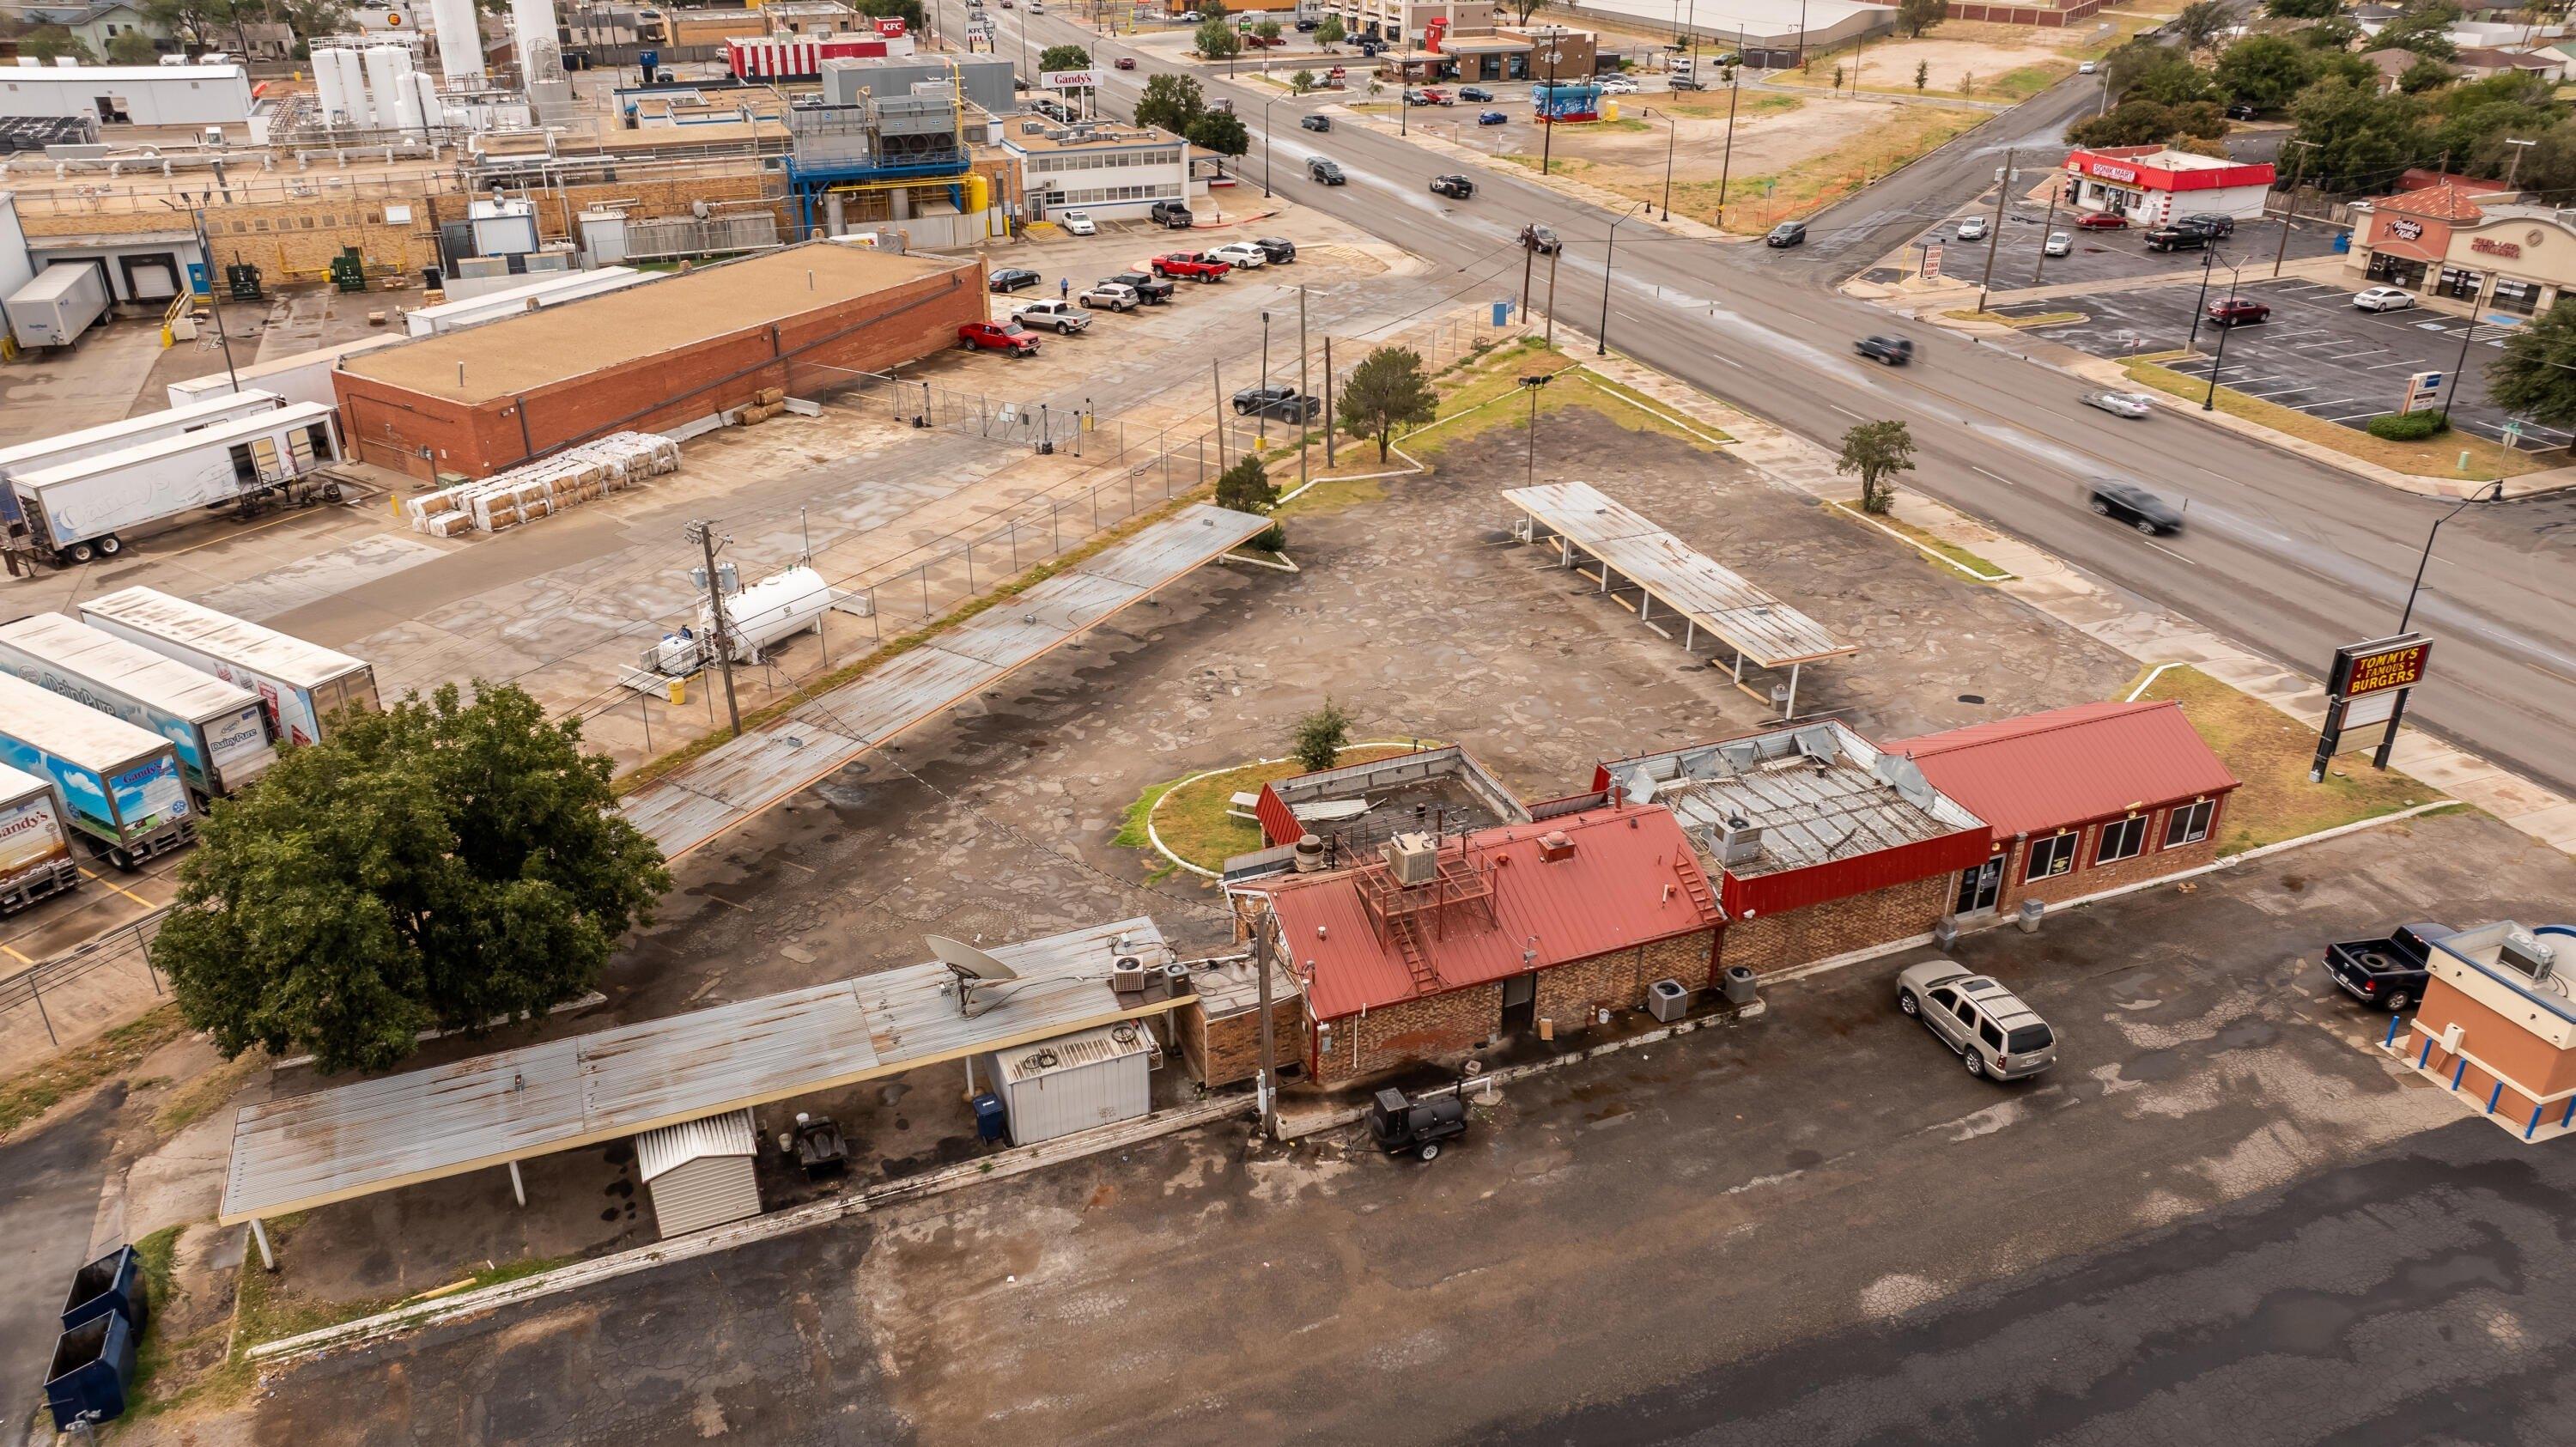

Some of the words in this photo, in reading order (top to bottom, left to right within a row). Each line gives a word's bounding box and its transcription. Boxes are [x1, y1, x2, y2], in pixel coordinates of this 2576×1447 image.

[883, 22, 902, 31] KFC
[1054, 73, 1092, 85] Gandy's
[2114, 169, 2133, 179] MART
[2360, 648, 2420, 670] TOMMY'S
[2365, 661, 2405, 679] FAMOUS
[2351, 670, 2415, 692] BURGERS
[123, 762, 163, 784] Gandy's
[0, 811, 49, 839] andy's
